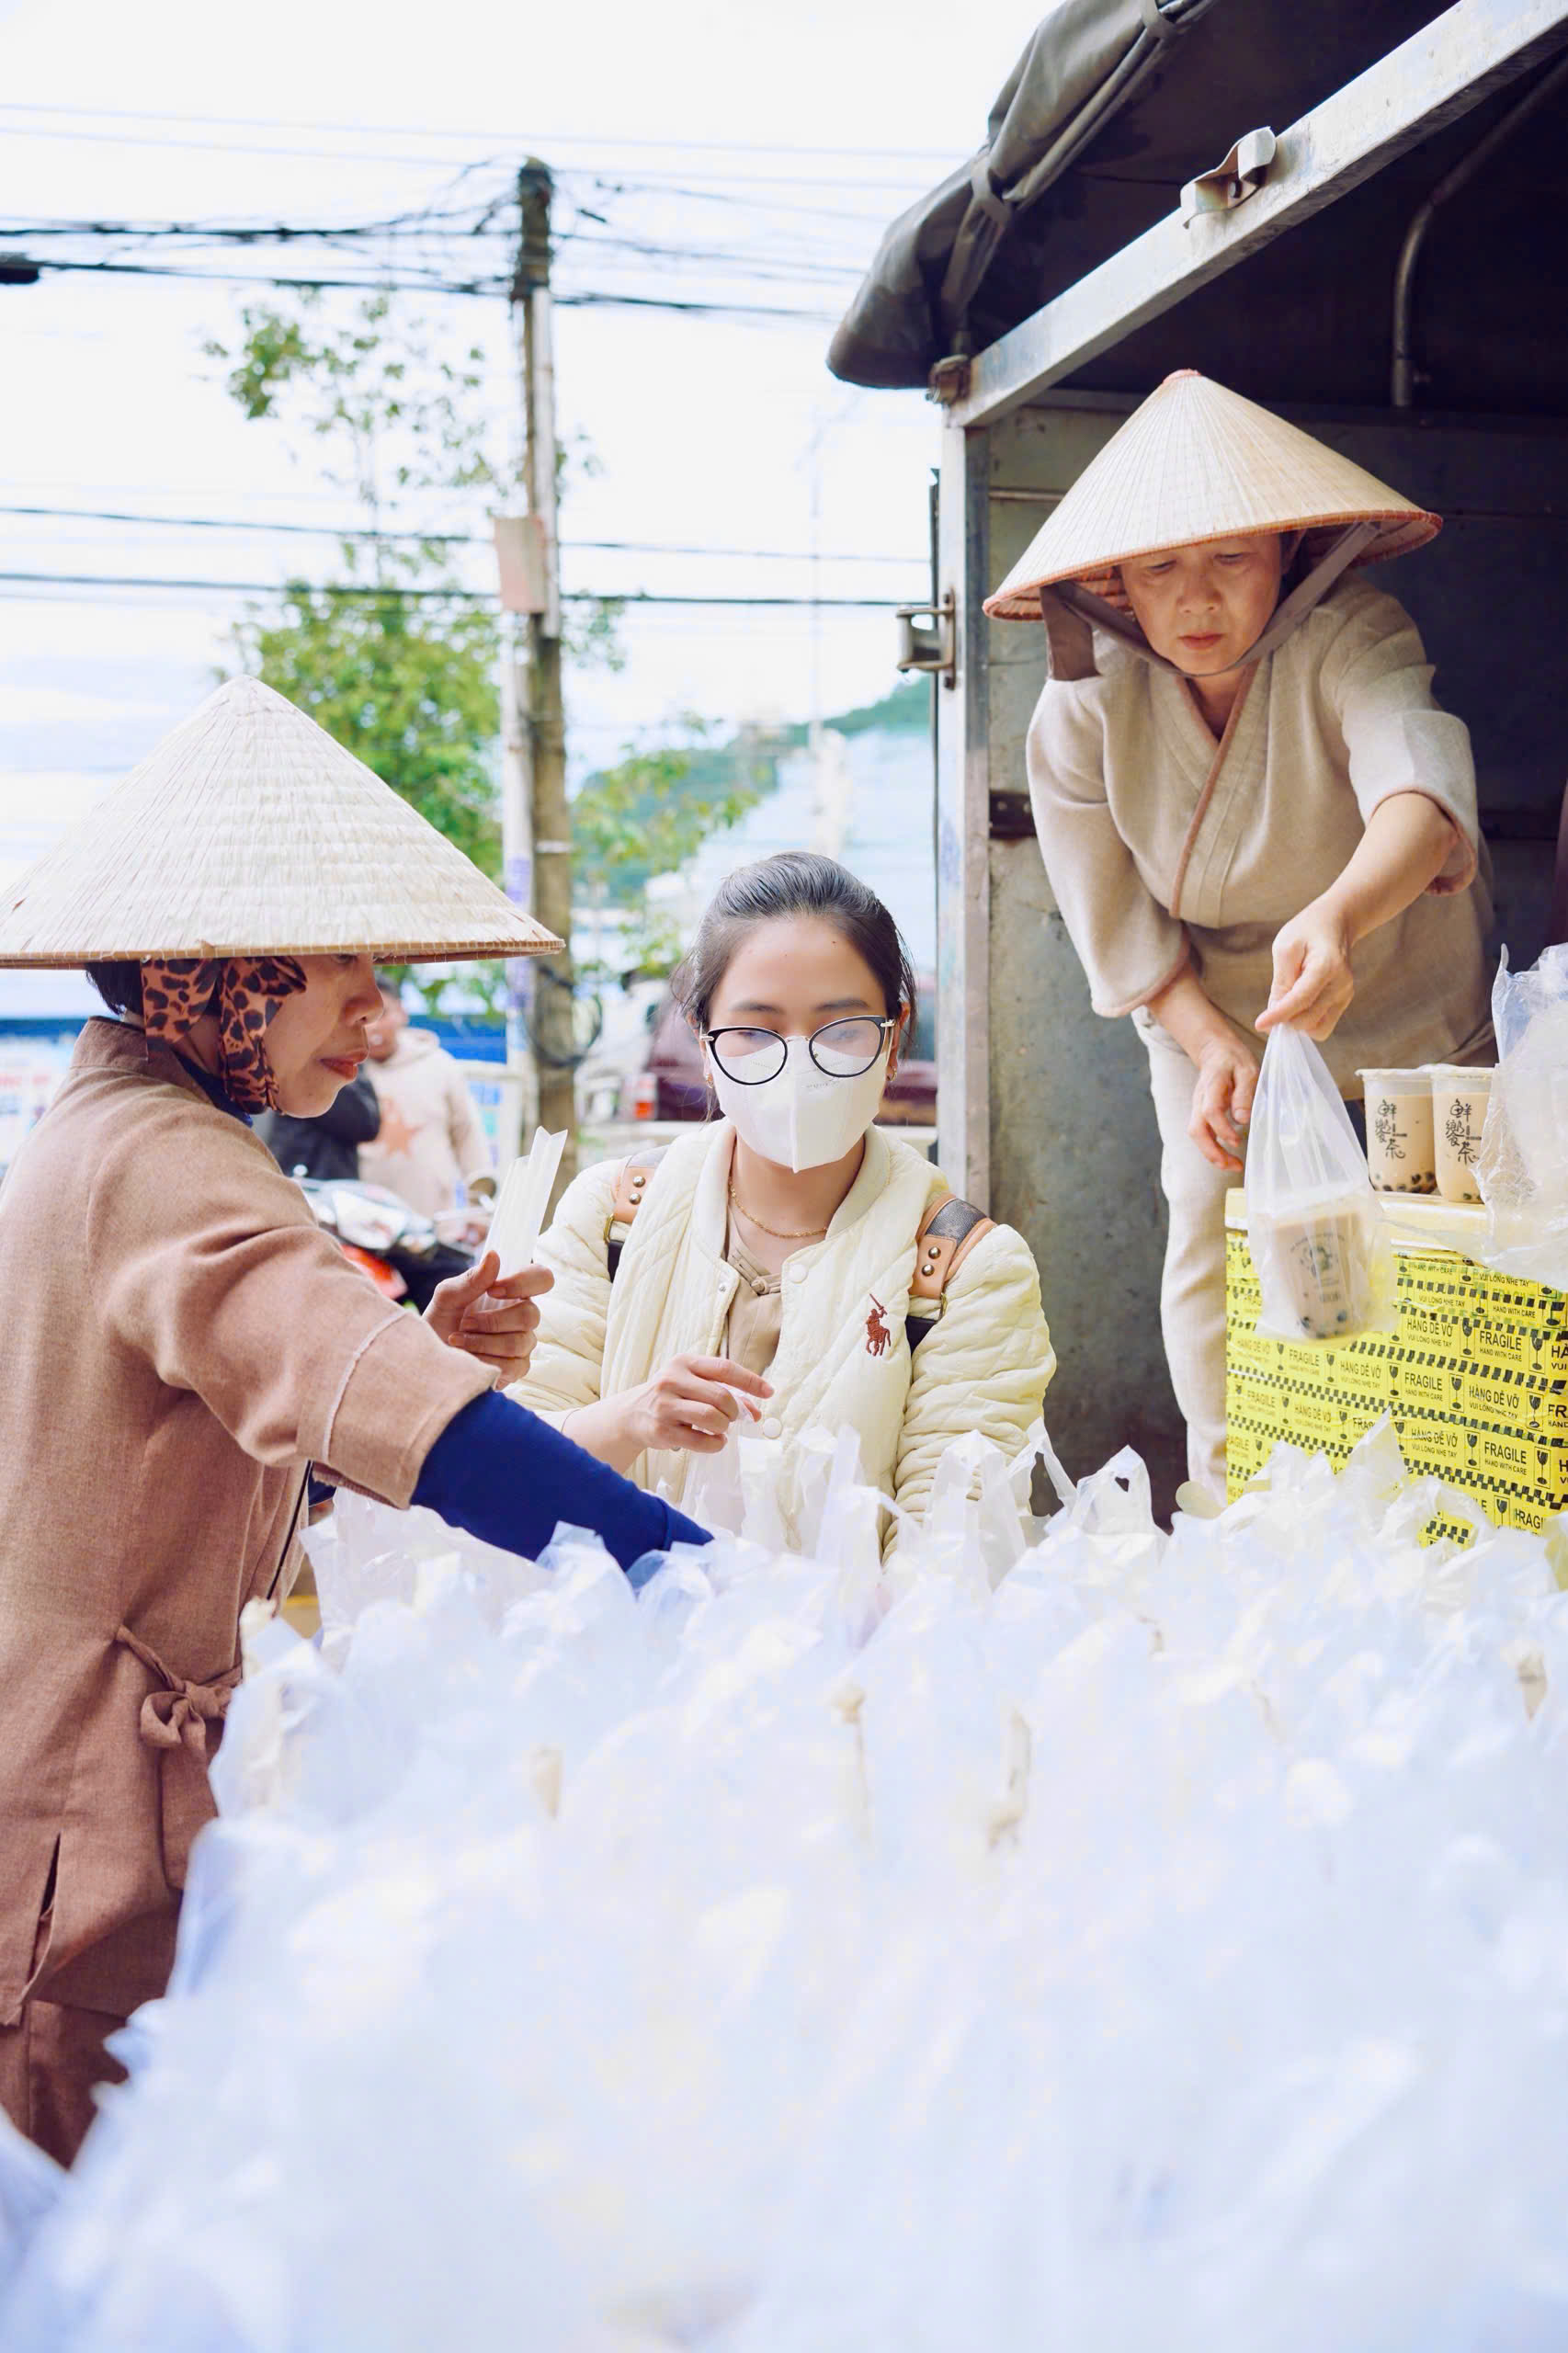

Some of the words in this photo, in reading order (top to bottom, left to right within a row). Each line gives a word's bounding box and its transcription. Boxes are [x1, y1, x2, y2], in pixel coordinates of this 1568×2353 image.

[1507, 1308, 1520, 1316] WITH
[1521, 1310, 1536, 1318] CARE
[1480, 1331, 1522, 1351] FRAGILE
[1290, 1348, 1319, 1367] FRAGILE
[1494, 1350, 1506, 1359] WITH
[1508, 1353, 1522, 1362] CARE
[1551, 1362, 1566, 1370] VUI
[1405, 1372, 1442, 1391] FRAGILE
[1430, 1393, 1442, 1402] CARE
[1485, 1441, 1527, 1464] FRAGILE
[1499, 1462, 1512, 1472] WITH
[1513, 1465, 1527, 1475] CARE
